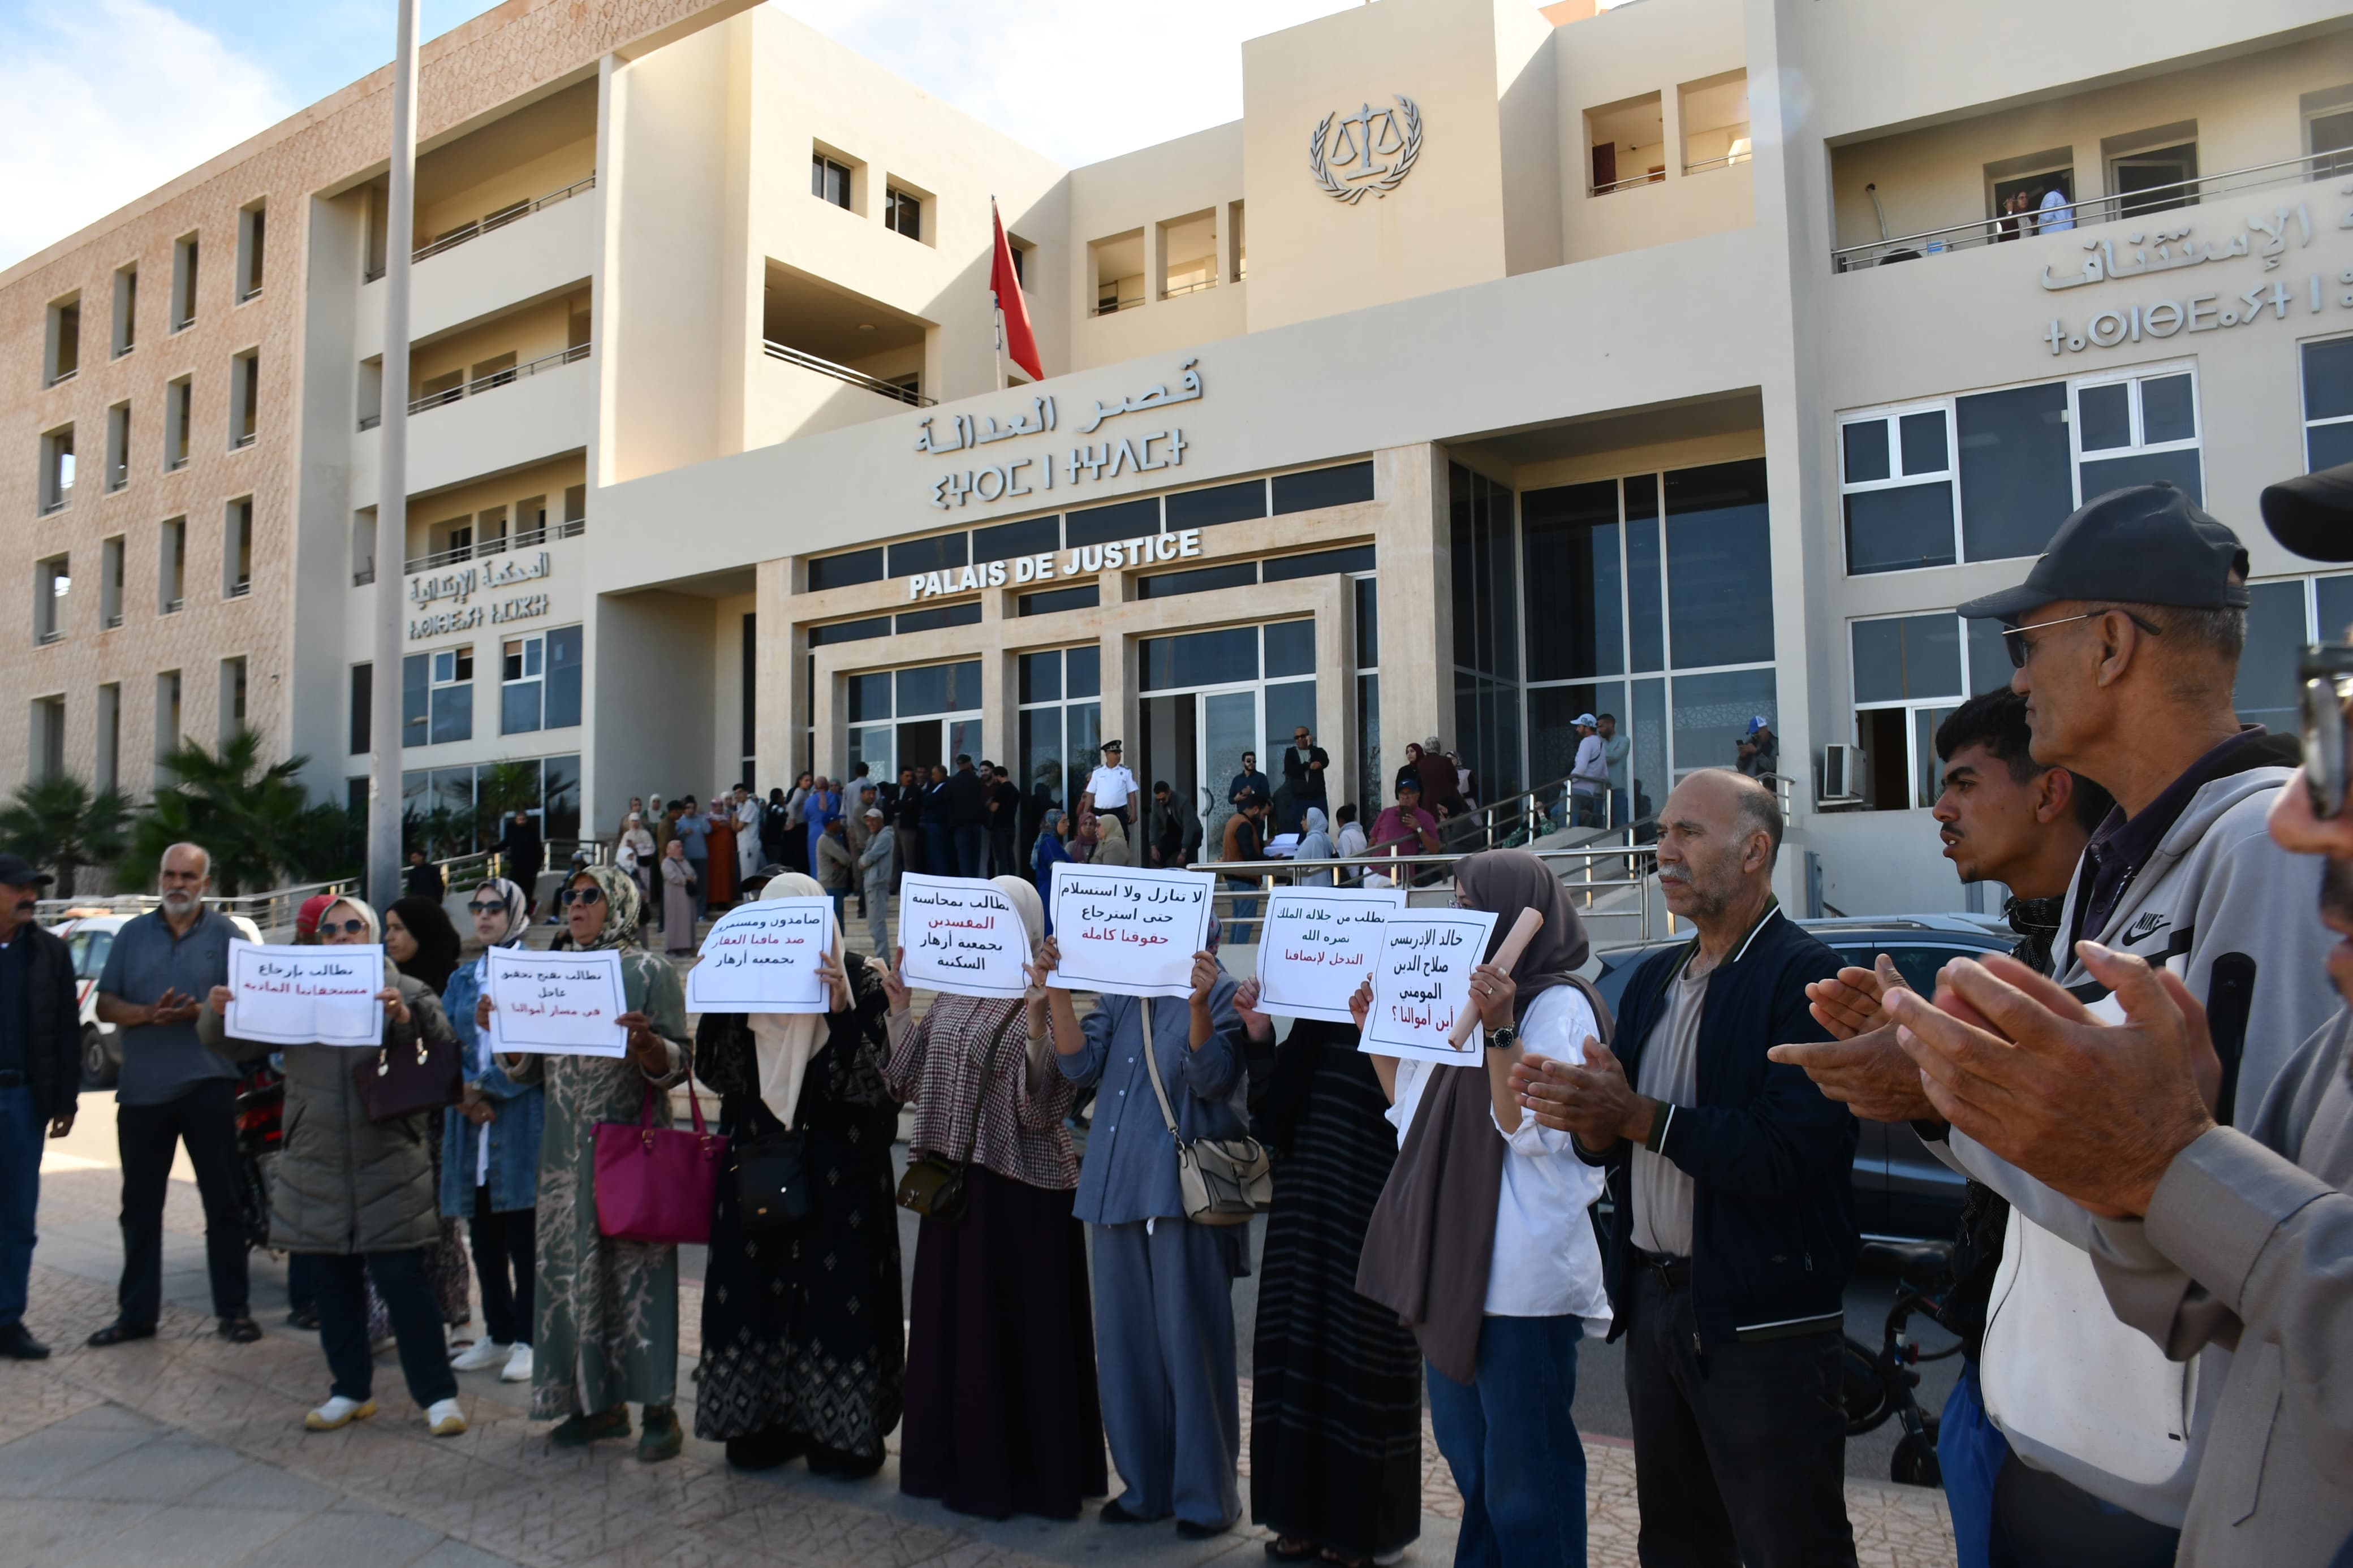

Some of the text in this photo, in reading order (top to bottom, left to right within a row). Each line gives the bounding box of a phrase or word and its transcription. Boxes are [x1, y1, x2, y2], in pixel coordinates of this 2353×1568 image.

[914, 358, 1203, 454] قصر العدالة
[482, 552, 550, 588] المحكمة
[909, 529, 1203, 600] PALAIS DE JUSTICE
[912, 892, 963, 910] بمحاسبة
[1061, 882, 1203, 904] لا تنازل ولا استسلام
[770, 913, 820, 927] صامدون
[928, 916, 994, 930] المفسدين
[1081, 905, 1173, 923] حتى استرجاع
[1277, 907, 1385, 925] نطلب من جلالة الملك
[2135, 912, 2164, 931] NIKE
[711, 933, 804, 949] ضد مافيا العقار
[920, 930, 1003, 954] بجمعية أزهار
[1081, 926, 1169, 947] حقوقنا كاملة
[1302, 929, 1350, 945] نصره الله
[1390, 928, 1463, 949] خالد الإدريسي
[715, 950, 794, 967] بجمعية أزهار
[937, 956, 985, 970] السكنية
[1285, 948, 1363, 966] التدخل لإنصافنا
[1394, 954, 1449, 977] صلاح الدين
[1399, 982, 1442, 1003] المومني
[1400, 1004, 1430, 1029] أموالنا
[1436, 1005, 1453, 1031] أين
